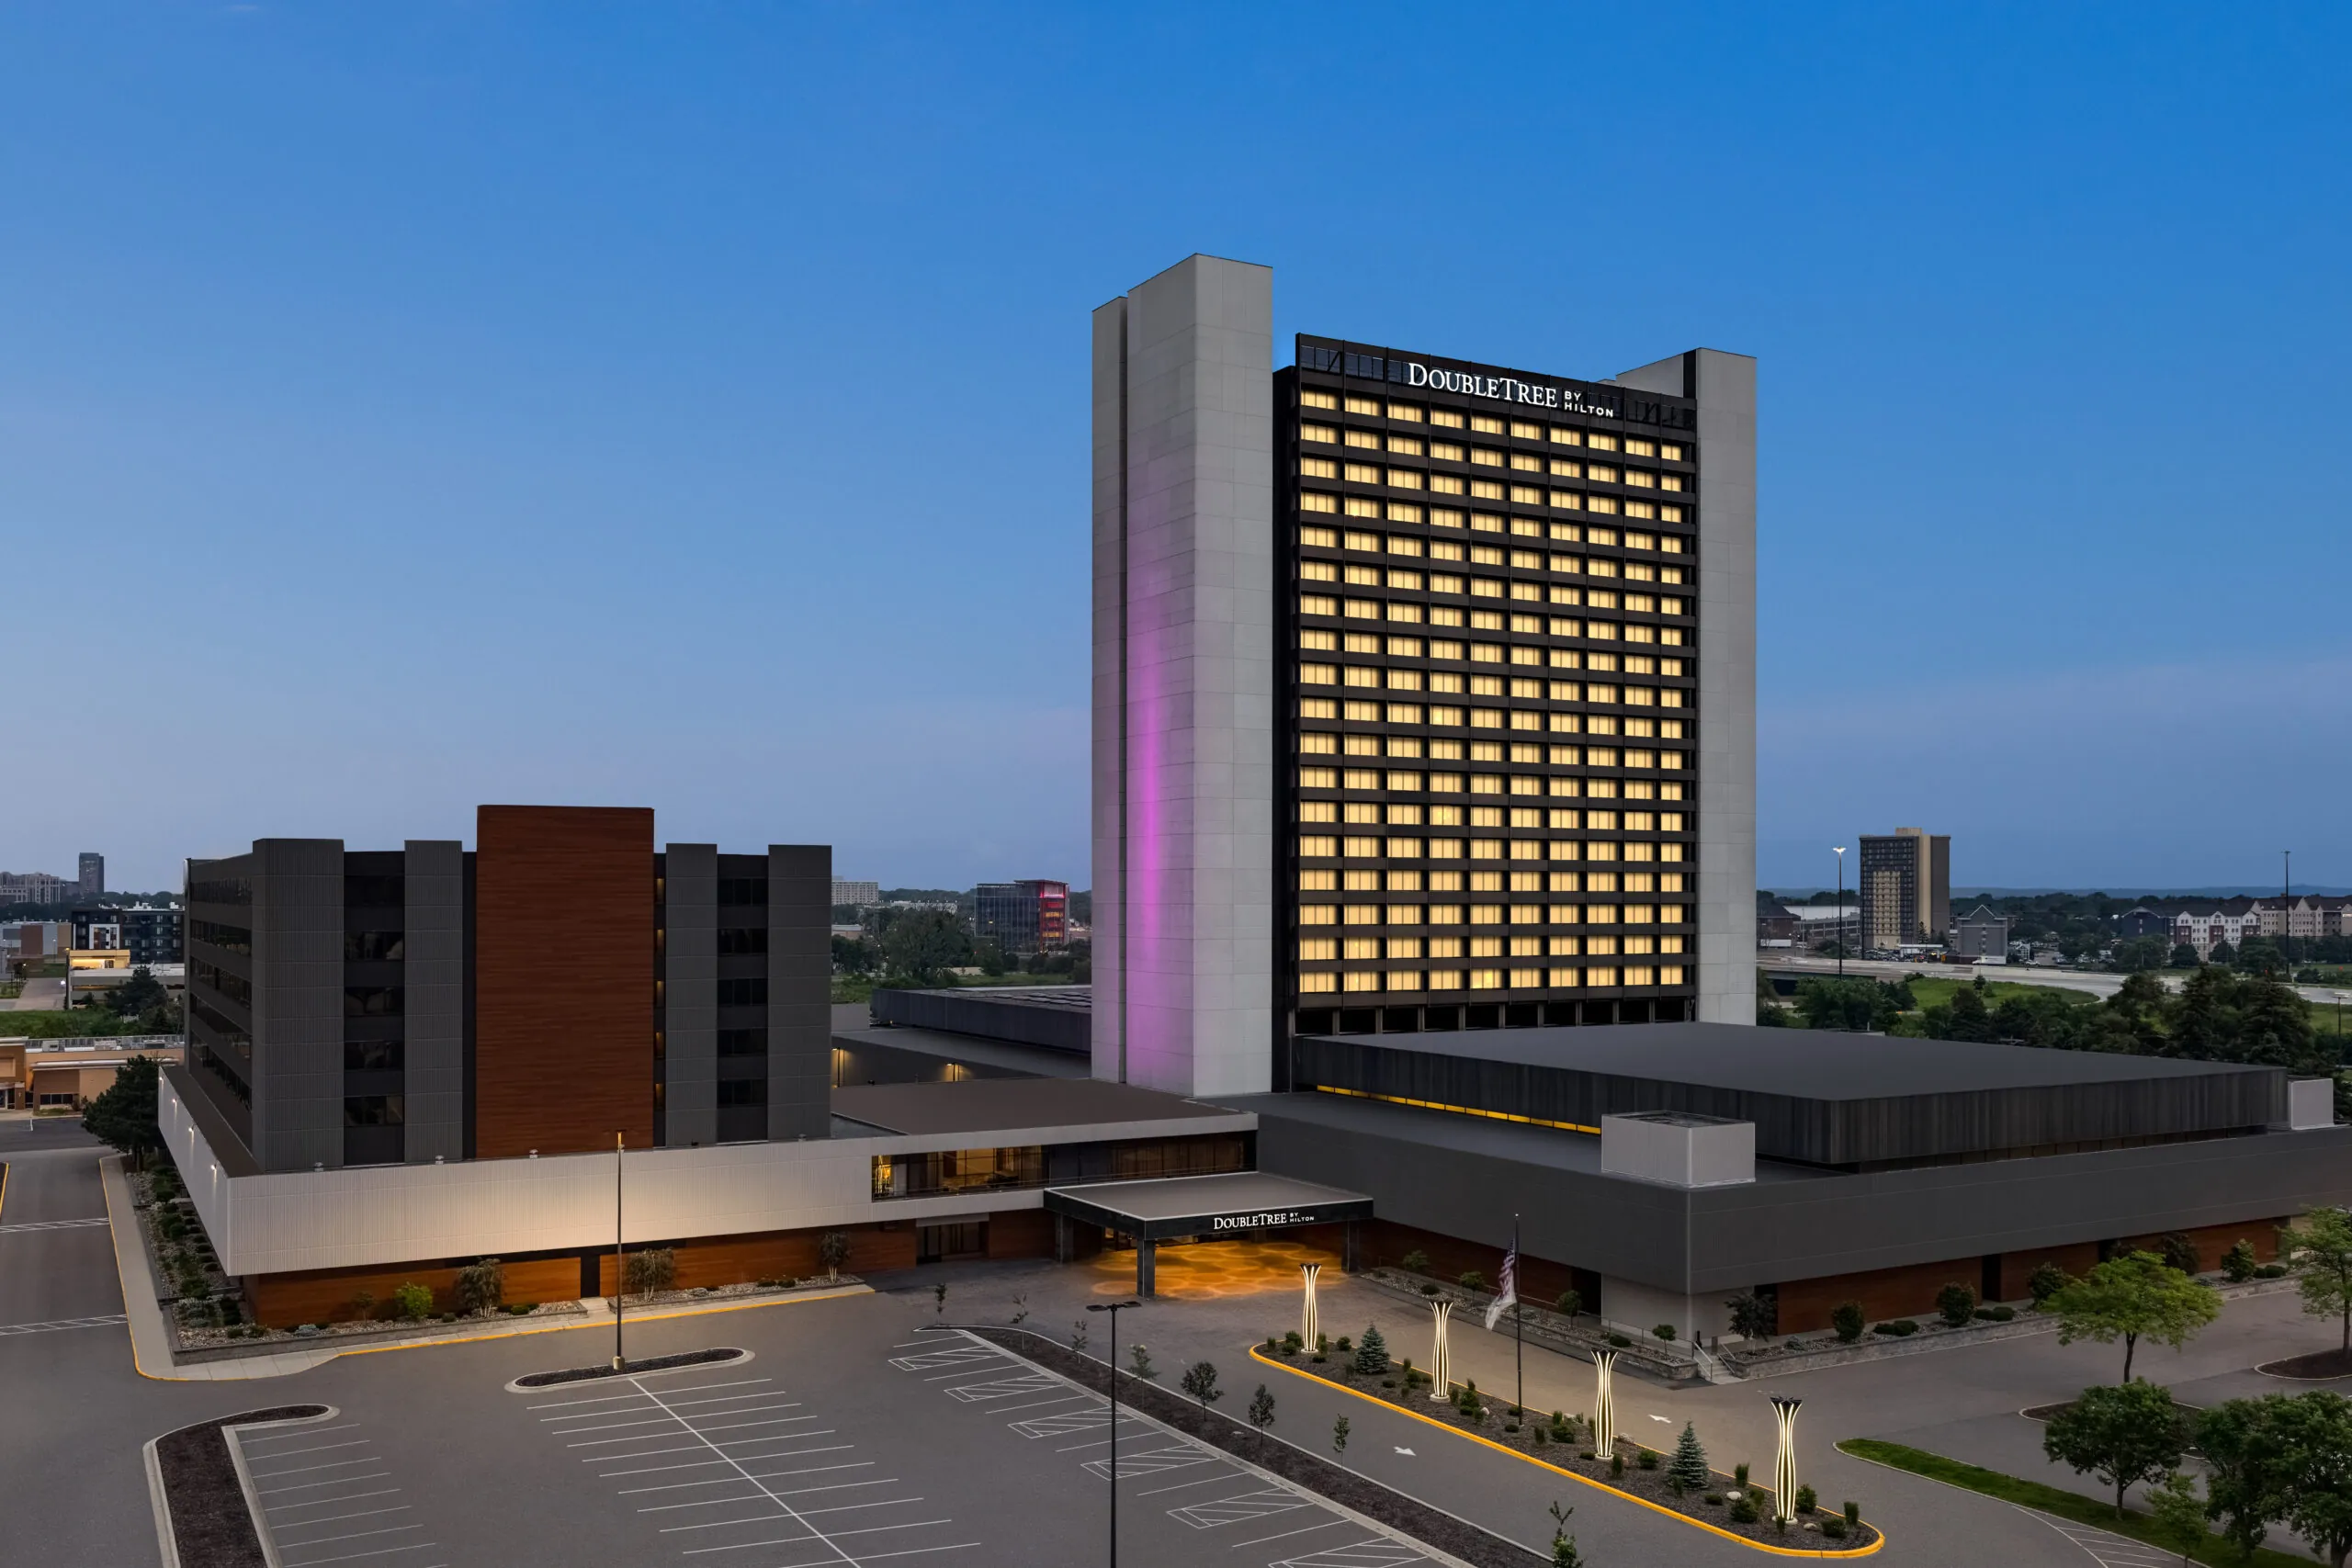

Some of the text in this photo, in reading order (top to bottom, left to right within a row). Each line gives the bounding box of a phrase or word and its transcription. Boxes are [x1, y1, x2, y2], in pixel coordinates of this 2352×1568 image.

[1408, 362, 1558, 408] DOUBLETREE
[1564, 390, 1581, 401] BY
[1564, 401, 1613, 418] HILTON
